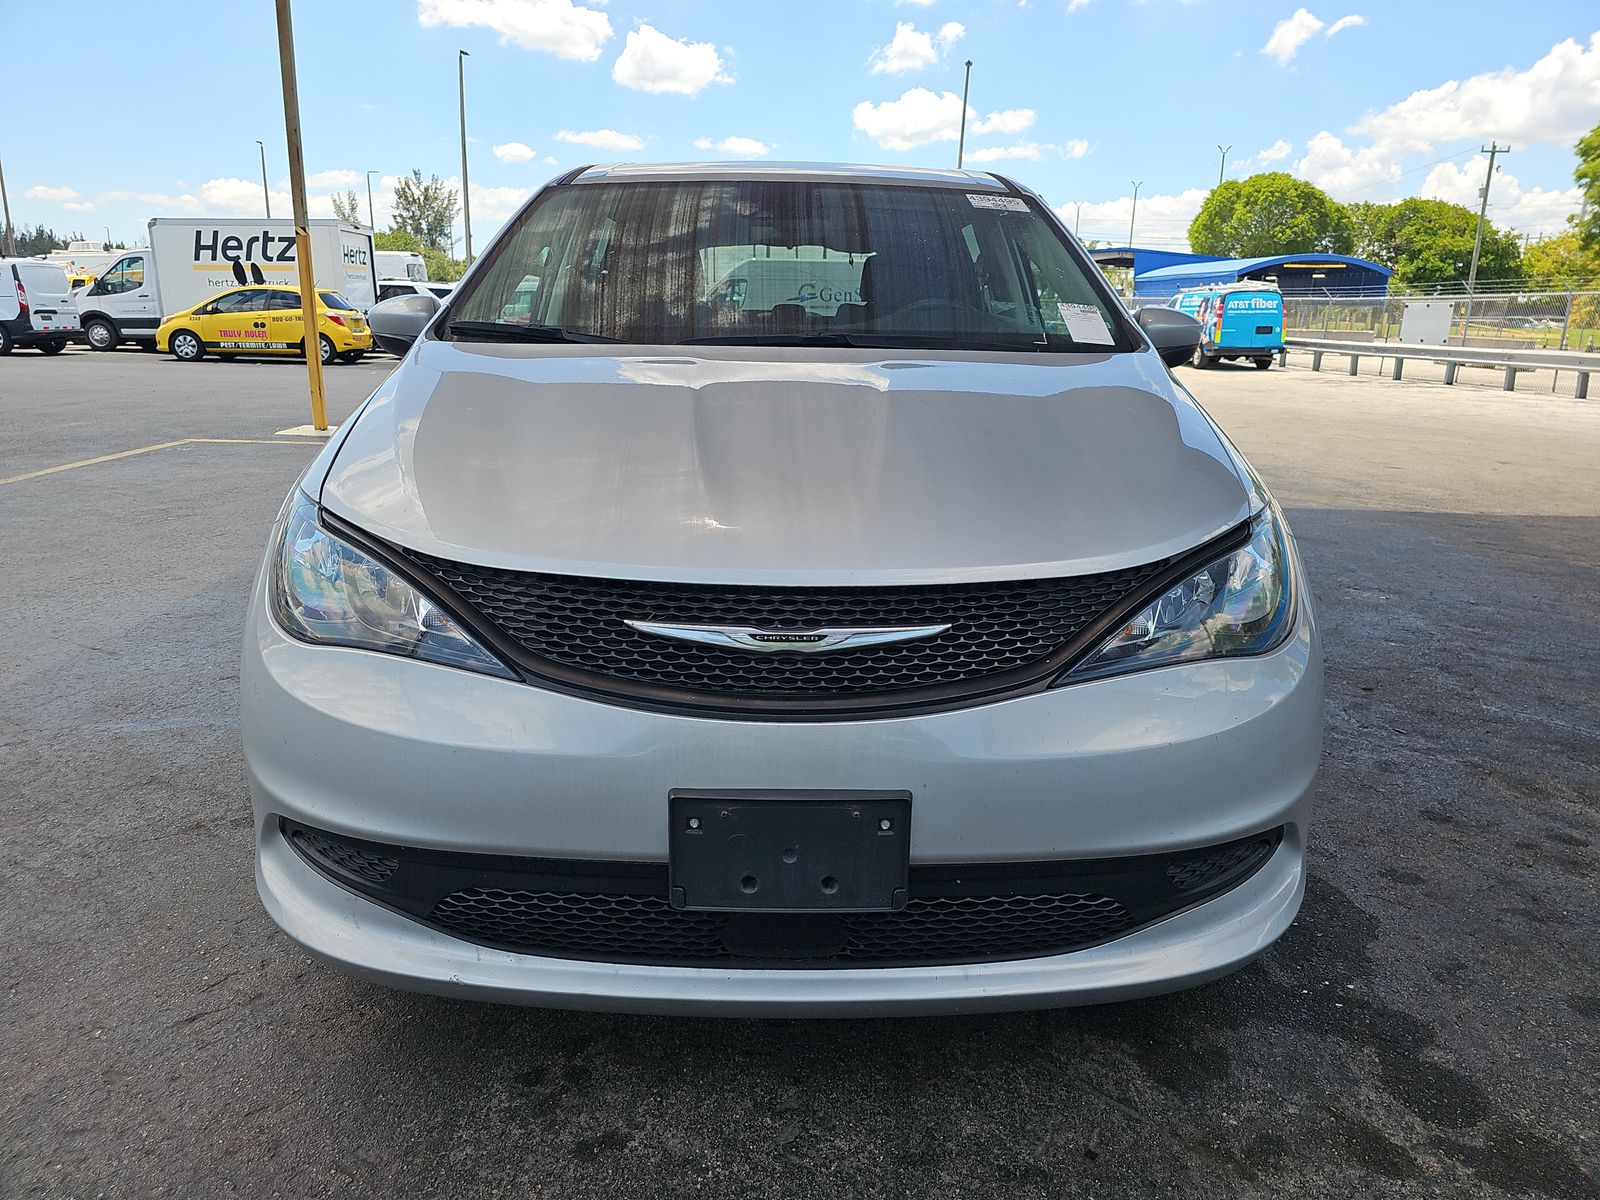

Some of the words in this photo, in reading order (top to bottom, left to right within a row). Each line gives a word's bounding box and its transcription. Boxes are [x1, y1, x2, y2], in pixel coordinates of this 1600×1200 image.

[969, 196, 1020, 205] 4394495
[194, 230, 297, 262] Hertz
[343, 244, 367, 266] Hertz
[1227, 300, 1250, 309] AT&T
[1251, 298, 1278, 309] fiber
